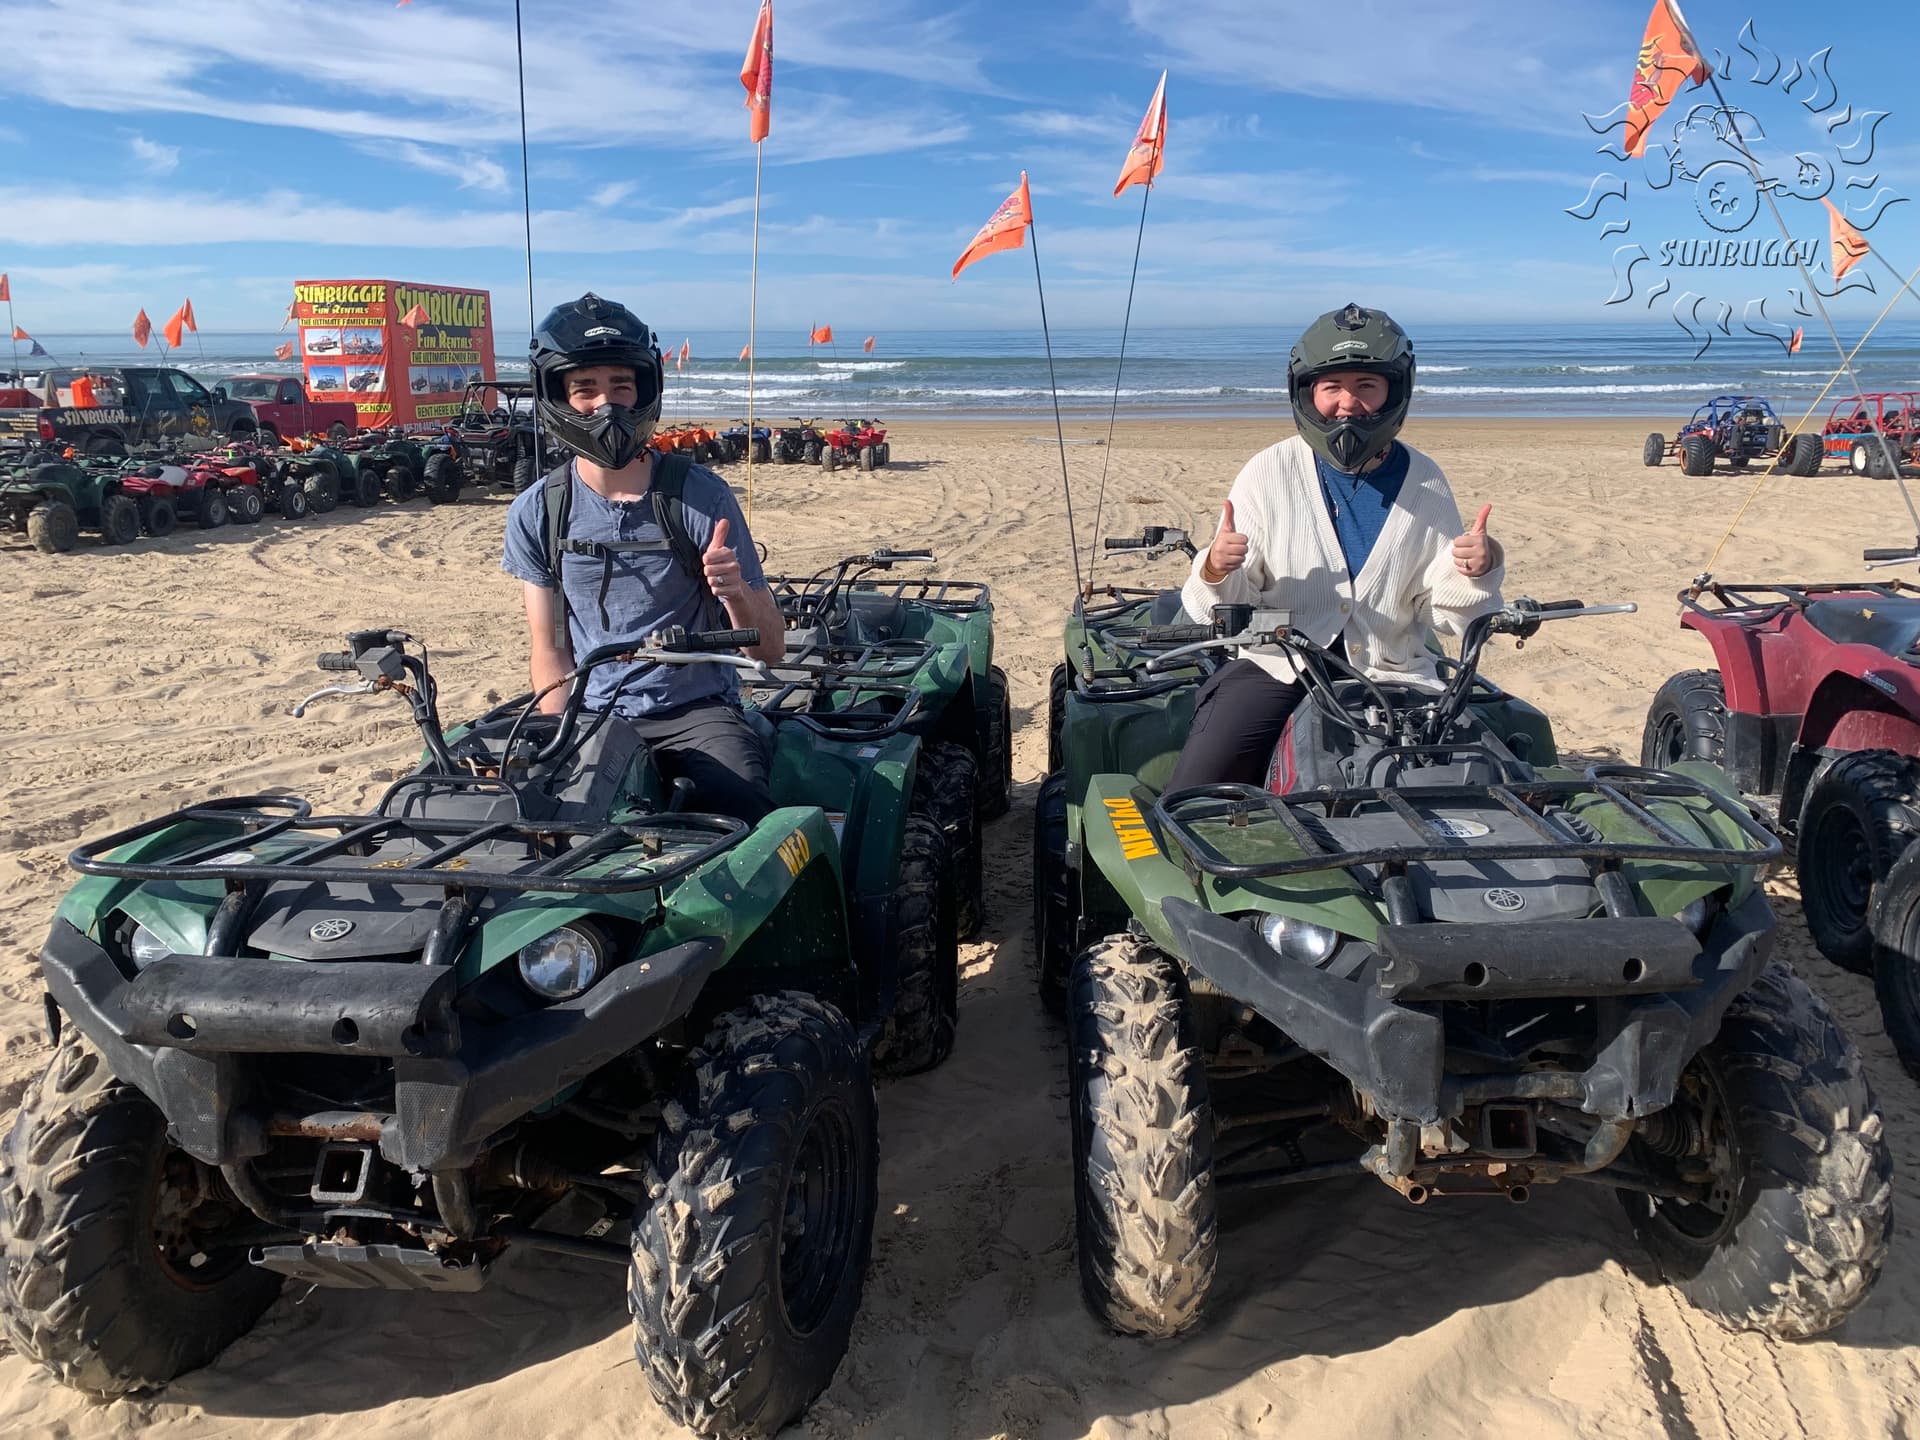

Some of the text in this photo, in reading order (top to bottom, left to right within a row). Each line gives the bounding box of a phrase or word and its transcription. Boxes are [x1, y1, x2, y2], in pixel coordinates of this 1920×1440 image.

[294, 285, 387, 303] SUNBUGGIE
[395, 286, 485, 328] SUNBUGGIE
[418, 407, 433, 417] RENT
[434, 406, 449, 416] HERE
[1103, 797, 1160, 861] DYLAN
